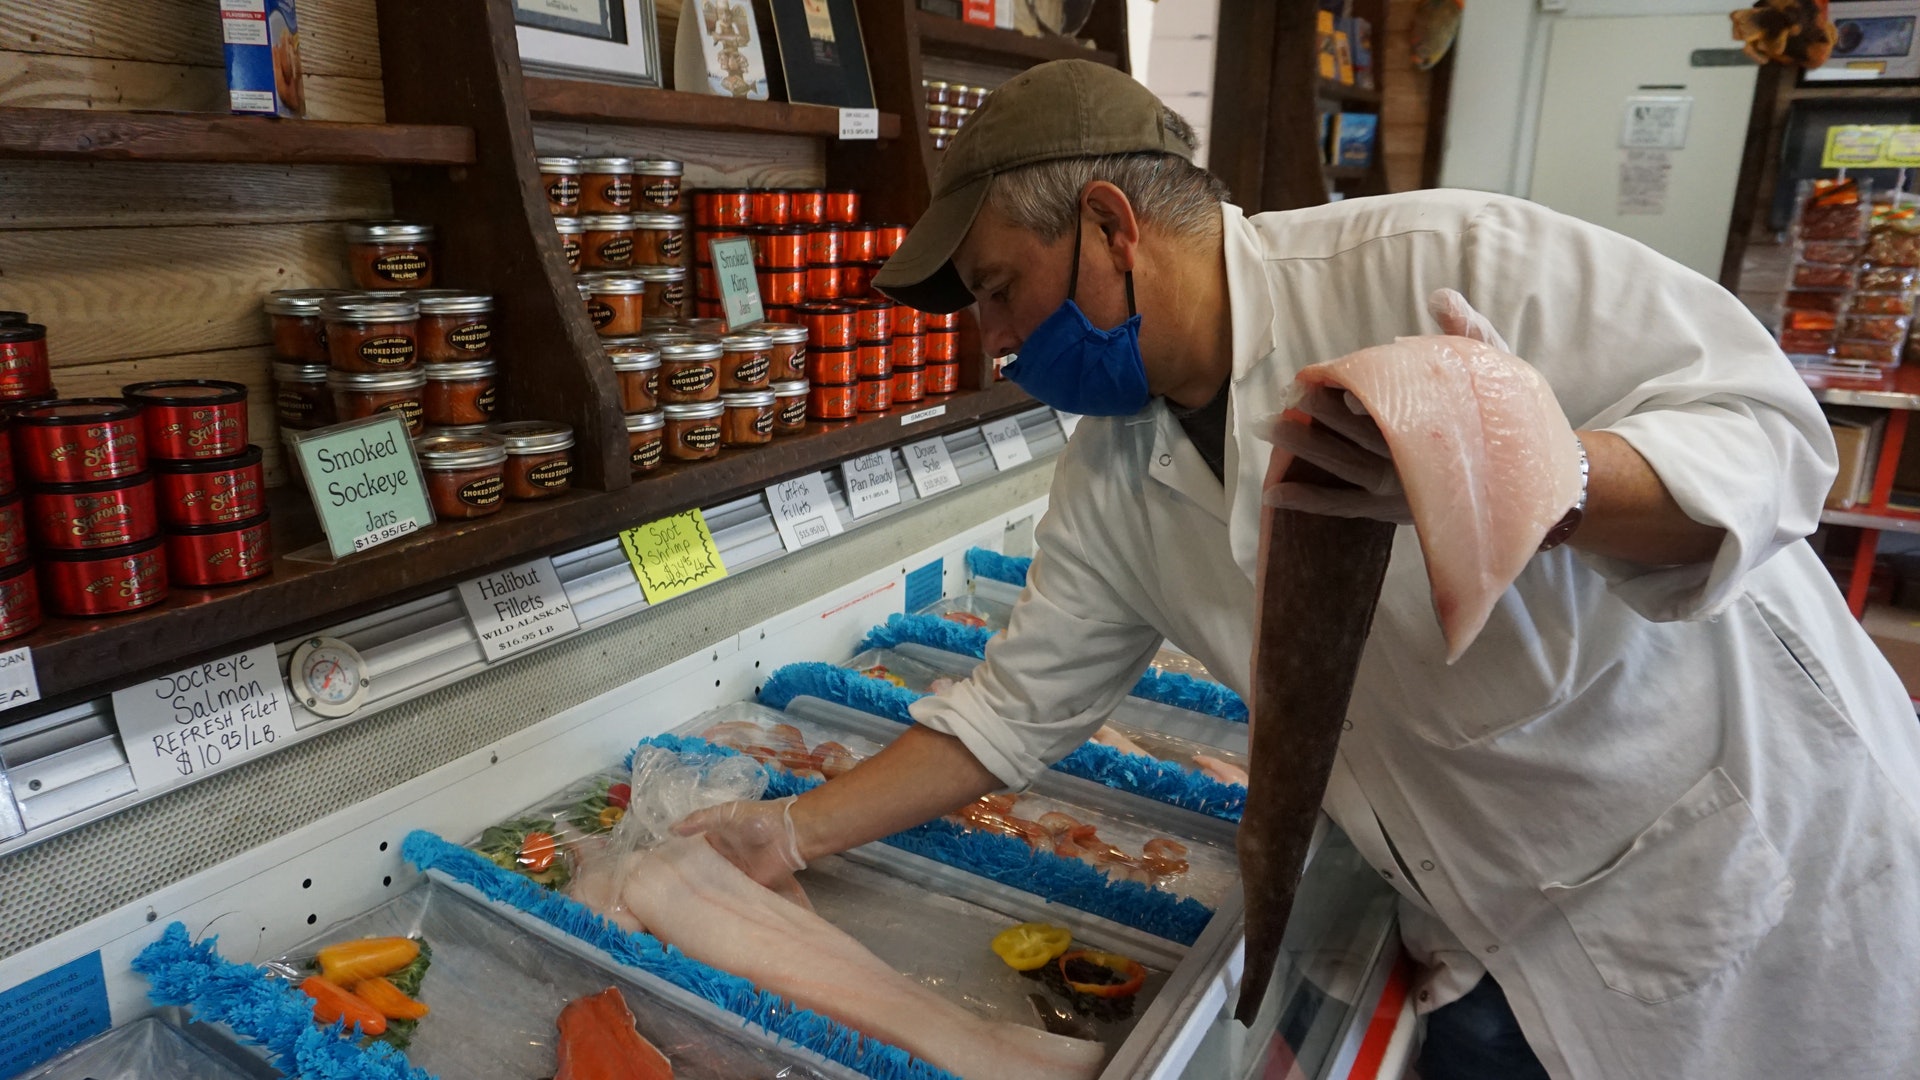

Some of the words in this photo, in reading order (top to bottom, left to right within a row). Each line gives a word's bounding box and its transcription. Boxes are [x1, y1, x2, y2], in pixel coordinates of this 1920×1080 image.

[720, 247, 749, 269] Smoked
[731, 274, 749, 294] King
[452, 333, 476, 342] SMOKED
[672, 376, 699, 385] SMOKED
[911, 408, 937, 421] SMOKED
[687, 433, 711, 441] SMOKED
[987, 431, 1005, 445] True
[1005, 424, 1020, 439] Cod
[318, 431, 398, 474] Smoked
[853, 452, 884, 472] Catfish
[913, 444, 937, 459] Dover
[532, 471, 555, 480] SMOKED
[922, 459, 942, 474] Sole
[328, 470, 408, 507] Sockeye
[777, 480, 809, 503] Catfish
[850, 479, 867, 493] Pan
[869, 468, 893, 488] Ready
[464, 488, 488, 498] SMOKED
[366, 510, 397, 532] Jars
[781, 501, 811, 521] Fillets
[355, 520, 417, 549] $13.95/EA
[649, 519, 681, 549] Spot
[647, 540, 690, 565] Shrimp
[477, 568, 541, 600] Halibut
[493, 595, 544, 622] Fillets
[482, 624, 514, 641] WILD
[517, 603, 570, 628] ALASKAN
[498, 632, 536, 650] $16.95
[539, 625, 554, 636] LB
[172, 680, 264, 724] Salmon
[153, 711, 233, 757] REFRESH
[16, 972, 79, 1006] recommends
[46, 996, 58, 1006] an
[60, 974, 98, 999] internal
[31, 1019, 69, 1042] opaque
[71, 1006, 89, 1022] and
[40, 1010, 51, 1022] of
[43, 1030, 65, 1049] with
[76, 1017, 96, 1033] fork
